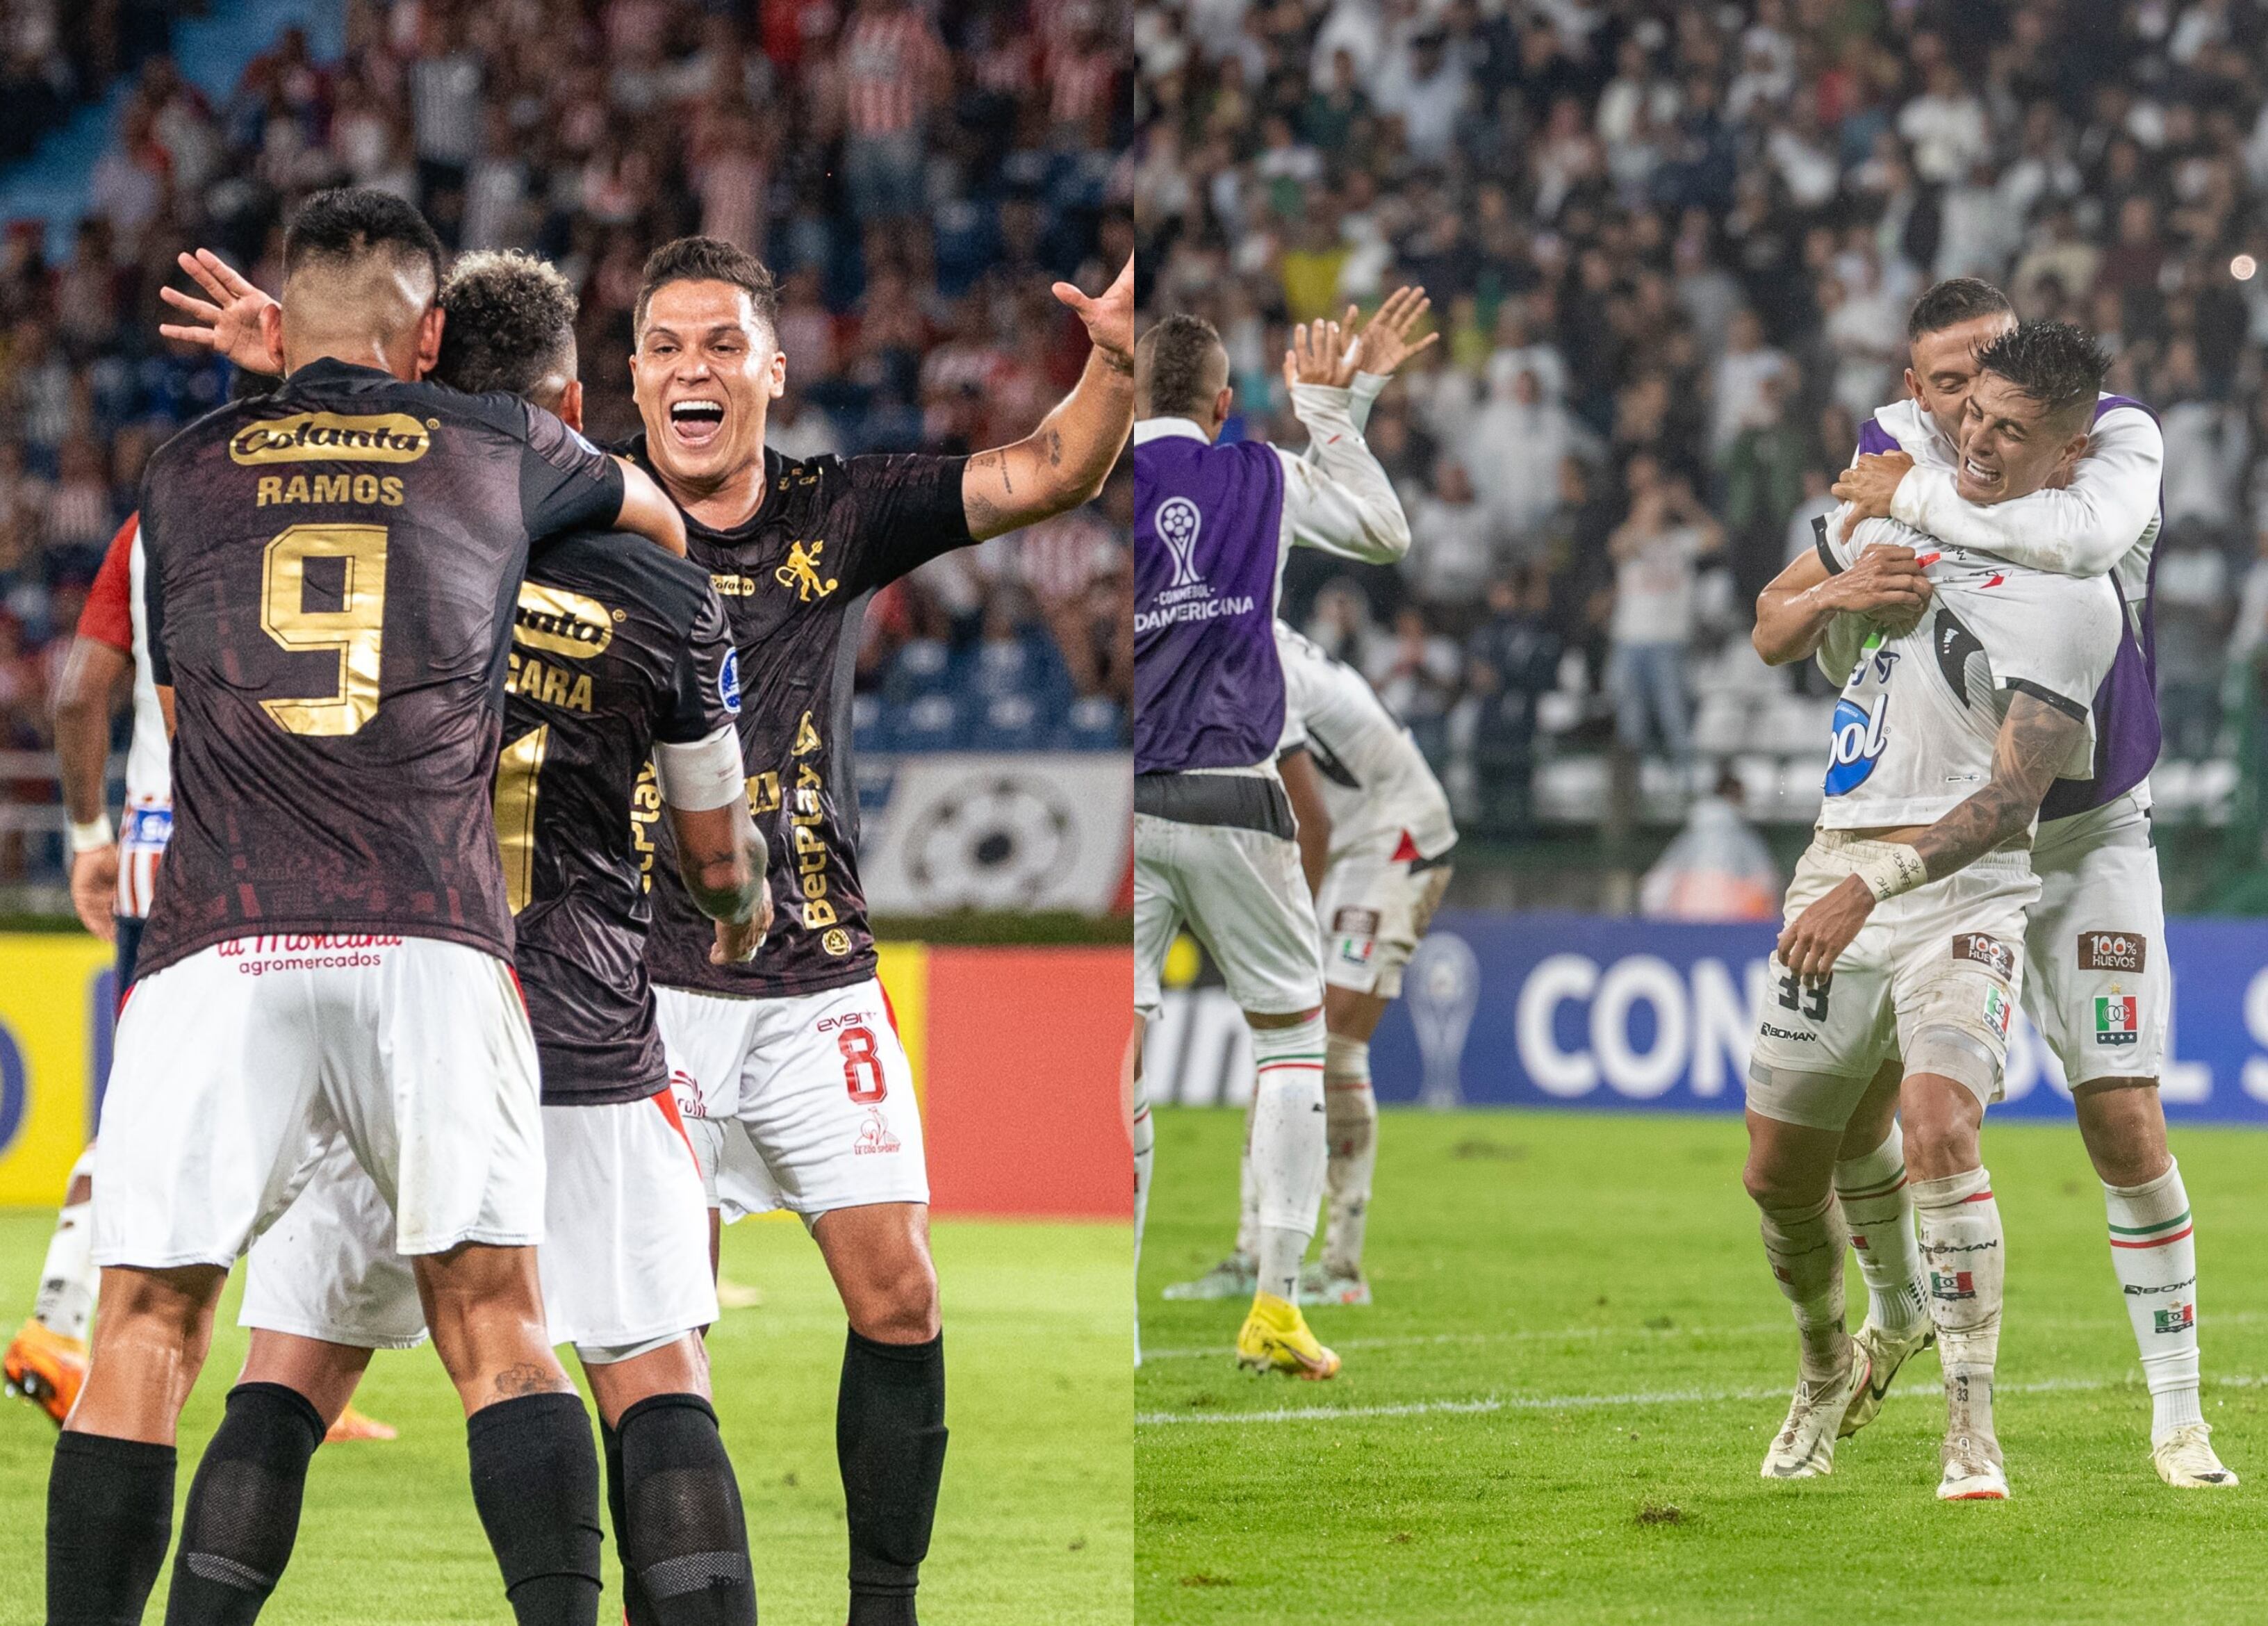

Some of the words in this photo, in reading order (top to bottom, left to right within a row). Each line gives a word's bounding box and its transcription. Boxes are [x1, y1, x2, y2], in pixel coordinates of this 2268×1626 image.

[235, 421, 421, 455] Colanta
[256, 474, 404, 507] RAMOS
[258, 523, 388, 737] 9
[791, 763, 838, 930] BetPlay
[2091, 935, 2137, 957] 100%
[2093, 955, 2135, 969] HUEVOS
[239, 951, 381, 976] agromercados
[1779, 971, 1833, 1022] 33
[1769, 1027, 1817, 1042] BOMAN
[838, 1026, 887, 1105] 8
[1957, 1388, 1969, 1402] 33
